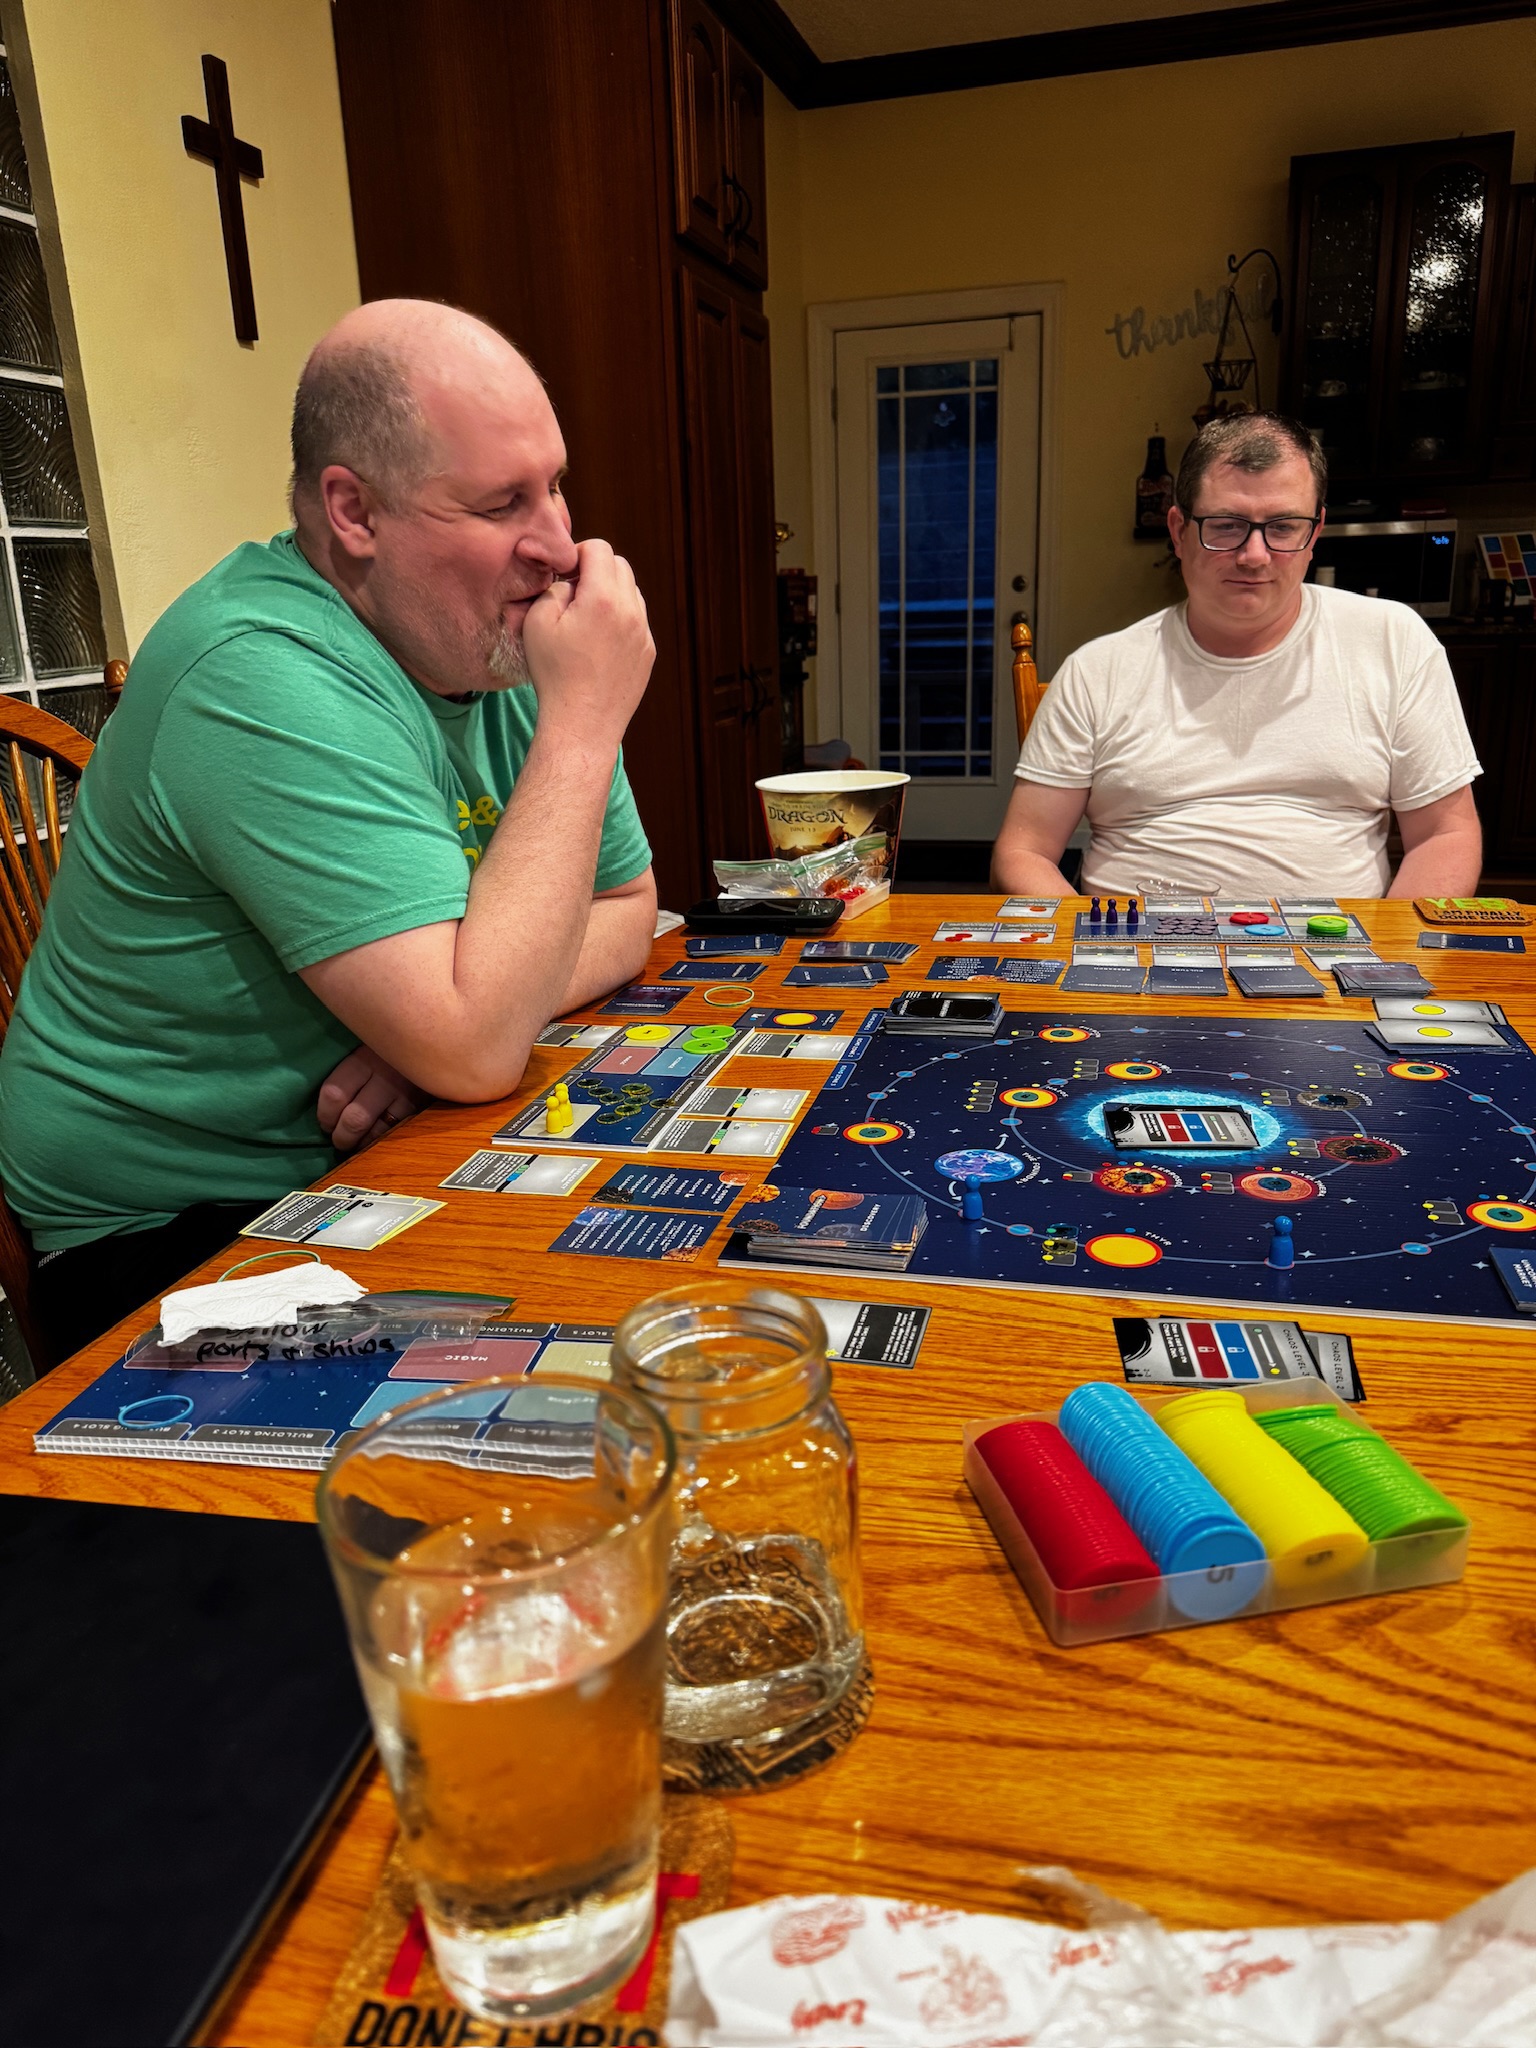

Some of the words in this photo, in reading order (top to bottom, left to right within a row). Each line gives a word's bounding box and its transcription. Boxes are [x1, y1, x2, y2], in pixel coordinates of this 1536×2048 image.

[471, 796, 499, 826] &
[768, 806, 848, 825] DRAGON
[1424, 898, 1508, 910] YES
[378, 1216, 403, 1235] BOYCOTT
[859, 1203, 882, 1232] DISCOVERY
[1145, 1231, 1172, 1246] THYR
[1512, 1263, 1532, 1288] MARKET
[1520, 1259, 1536, 1288] UNCOM
[313, 1337, 395, 1355] ships
[1282, 1329, 1297, 1348] CHAOS
[1292, 1351, 1307, 1368] LEVEL
[1331, 1342, 1340, 1361] CHAOS
[444, 1354, 488, 1362] MAGIC
[1334, 1364, 1343, 1382] LEVEL
[252, 1431, 314, 1439] BUILDING
[343, 2000, 489, 2047] DONE
